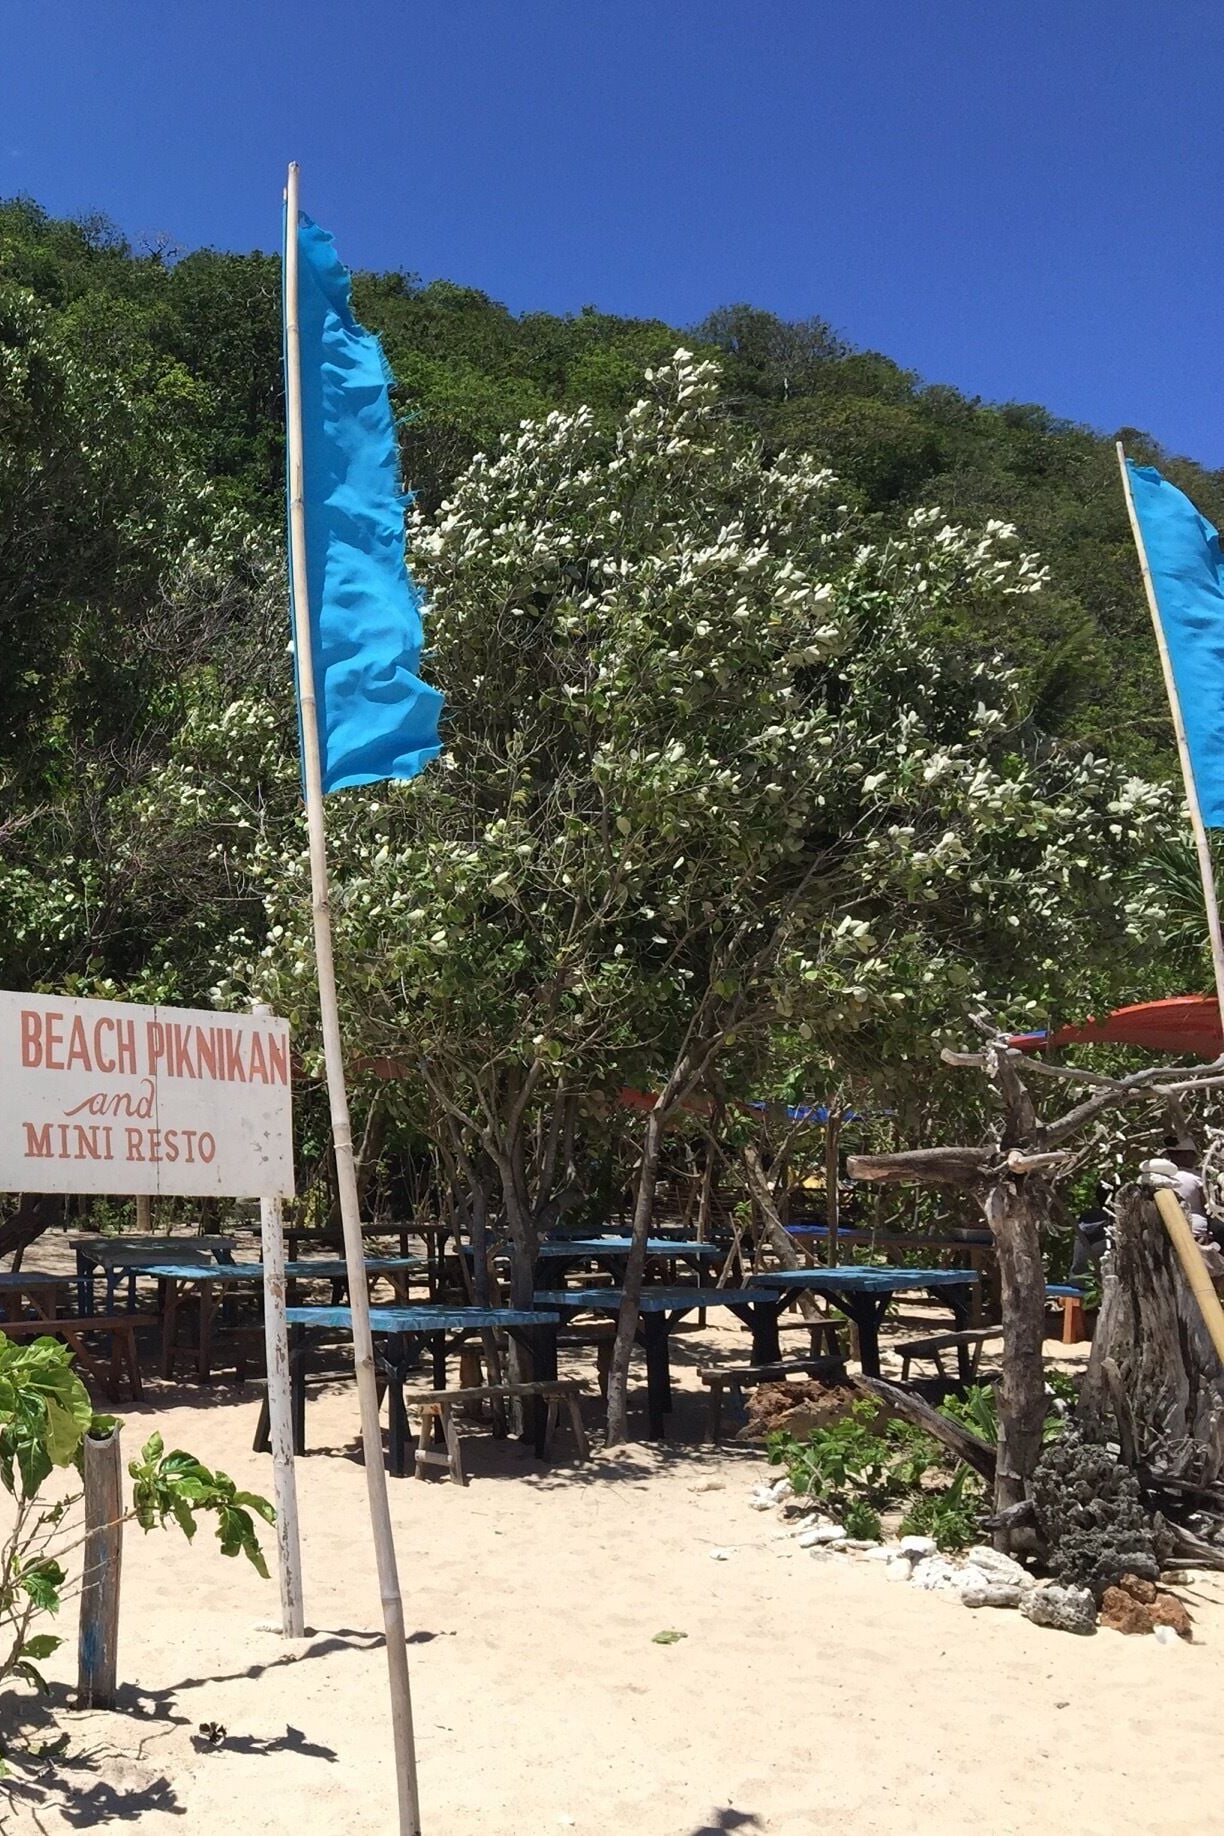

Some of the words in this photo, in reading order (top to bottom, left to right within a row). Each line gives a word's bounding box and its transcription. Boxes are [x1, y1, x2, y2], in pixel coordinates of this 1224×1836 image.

[21, 1010, 136, 1075] BEACH
[147, 1021, 287, 1086] PIKNIKAN
[64, 1078, 155, 1118] and
[22, 1122, 114, 1160] MINI
[125, 1127, 216, 1163] RESTO
